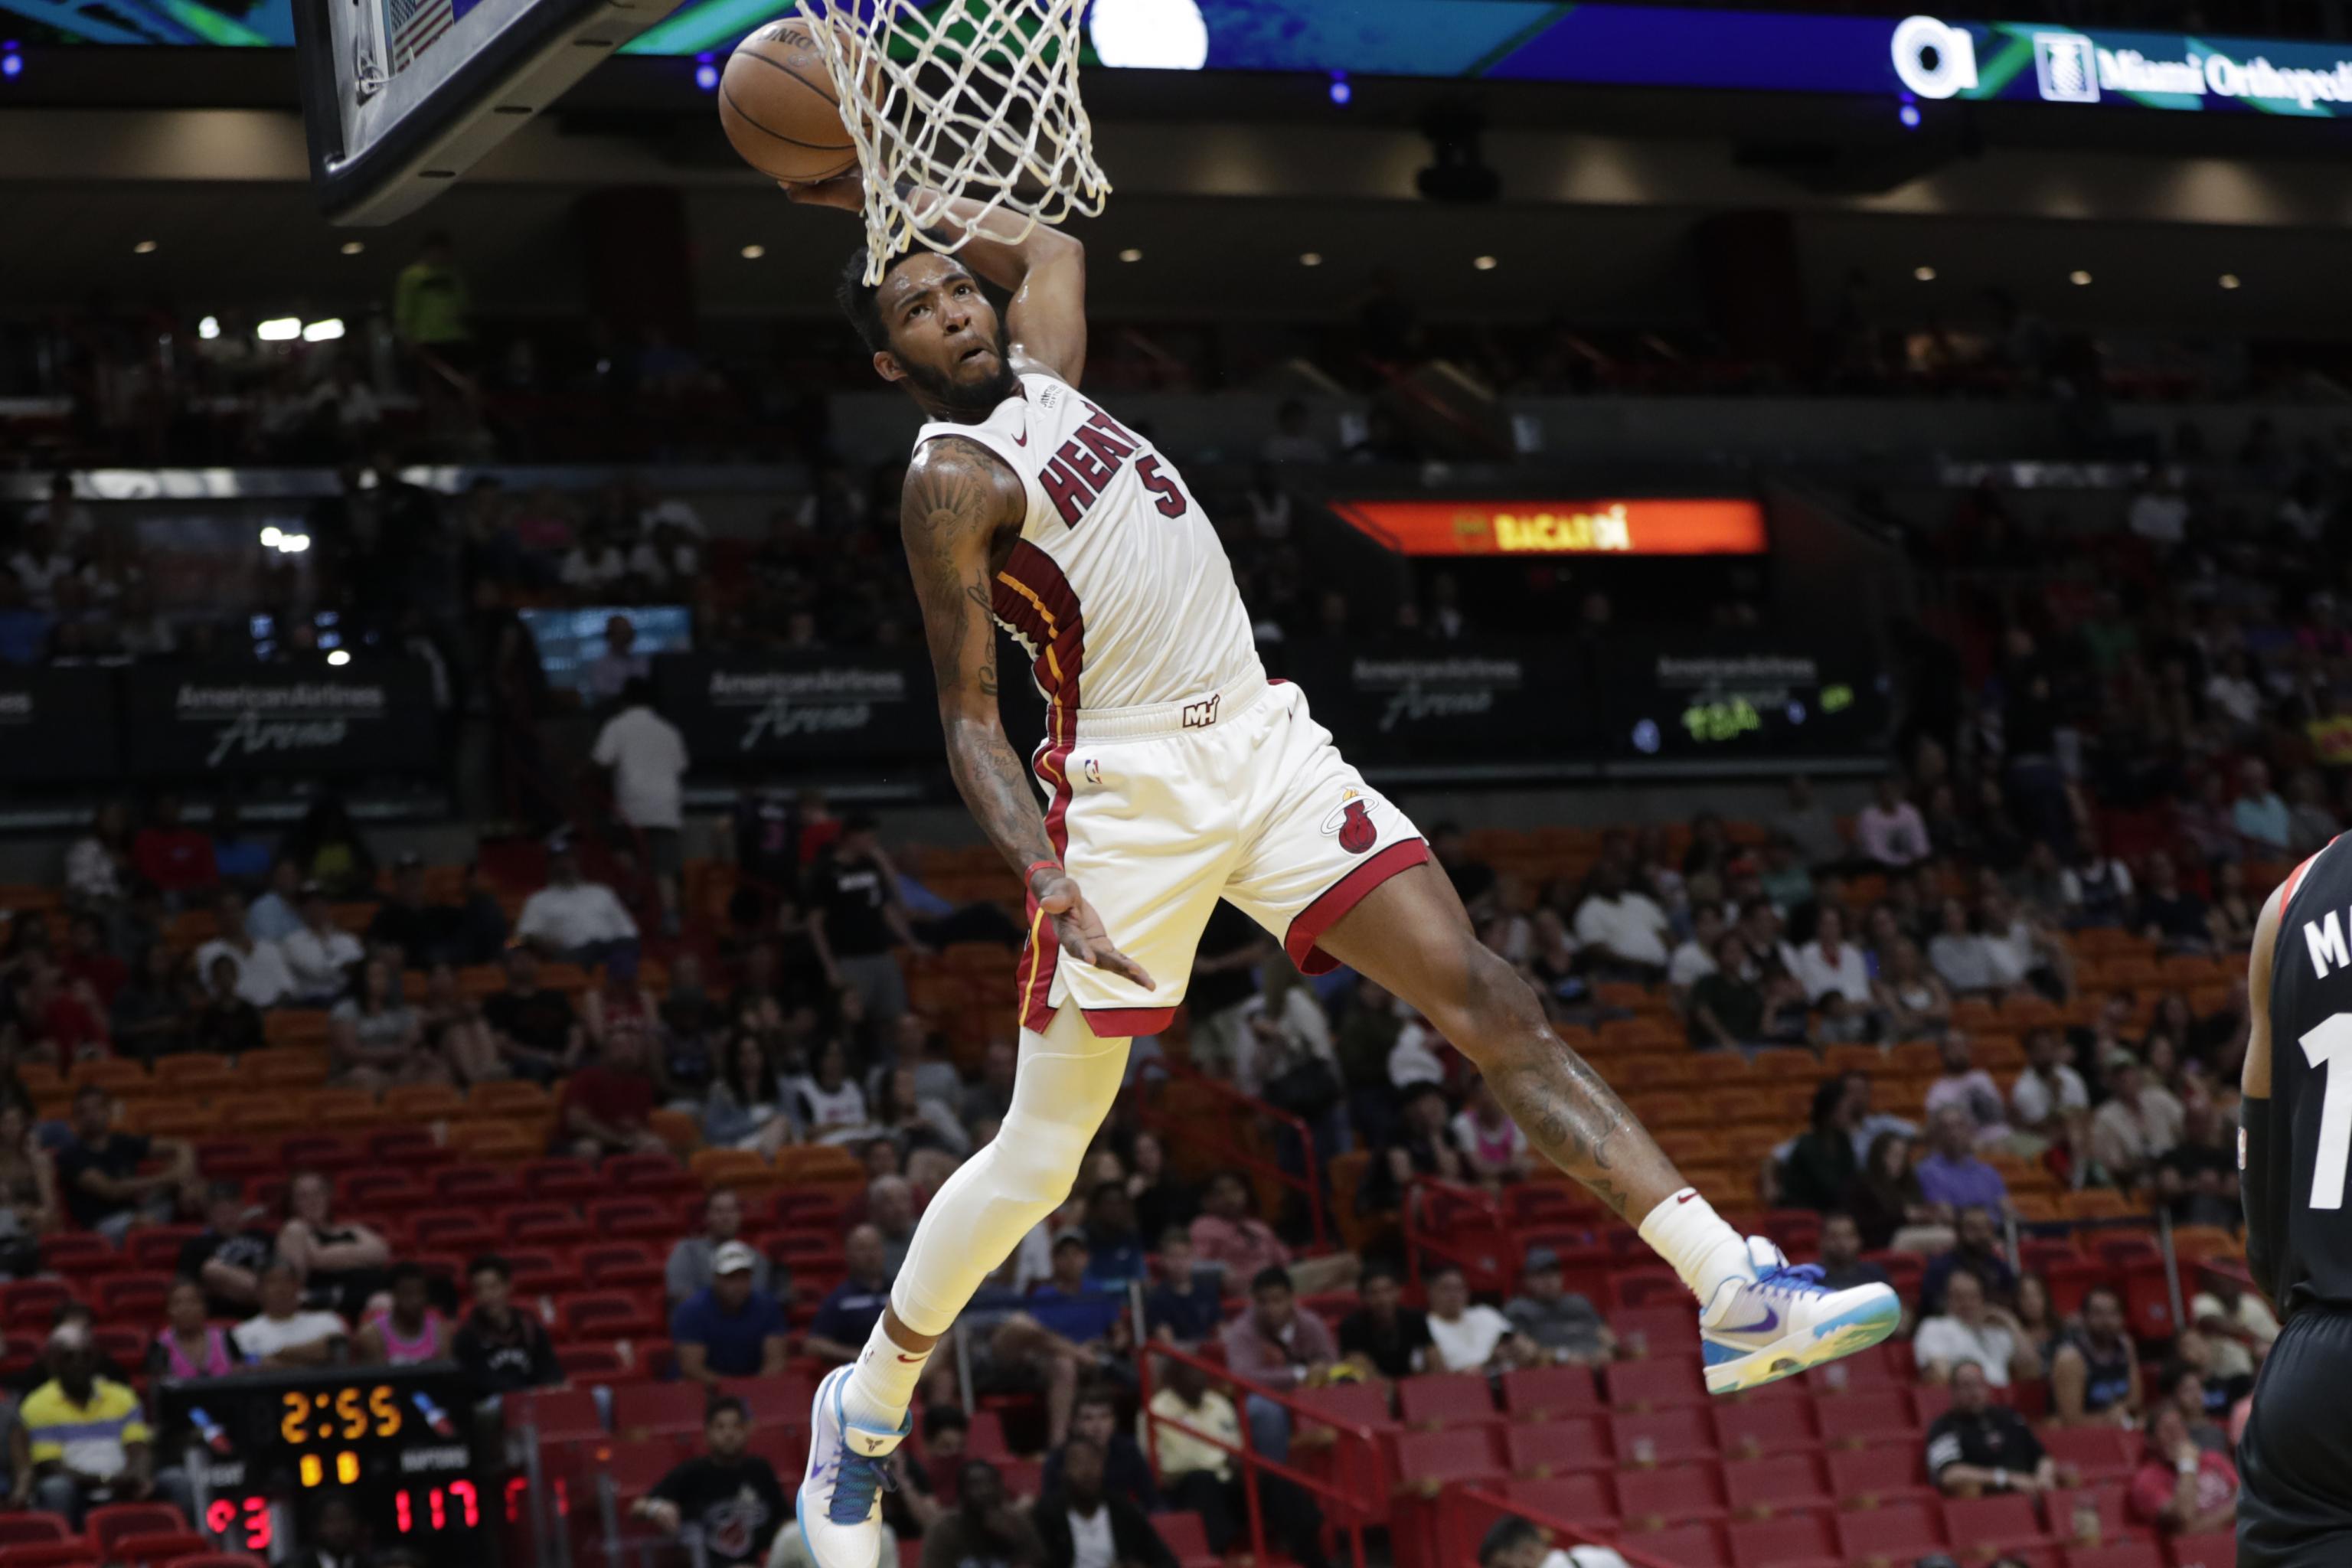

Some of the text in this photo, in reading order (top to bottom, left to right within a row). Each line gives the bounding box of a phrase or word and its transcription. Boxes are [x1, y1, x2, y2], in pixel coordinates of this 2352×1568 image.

[2096, 47, 2207, 95] Miami
[1038, 400, 1142, 531] HEAT
[1135, 453, 1187, 519] 5
[2303, 906, 2352, 979] M
[281, 1384, 402, 1444] 2:55
[394, 1478, 479, 1534] 117
